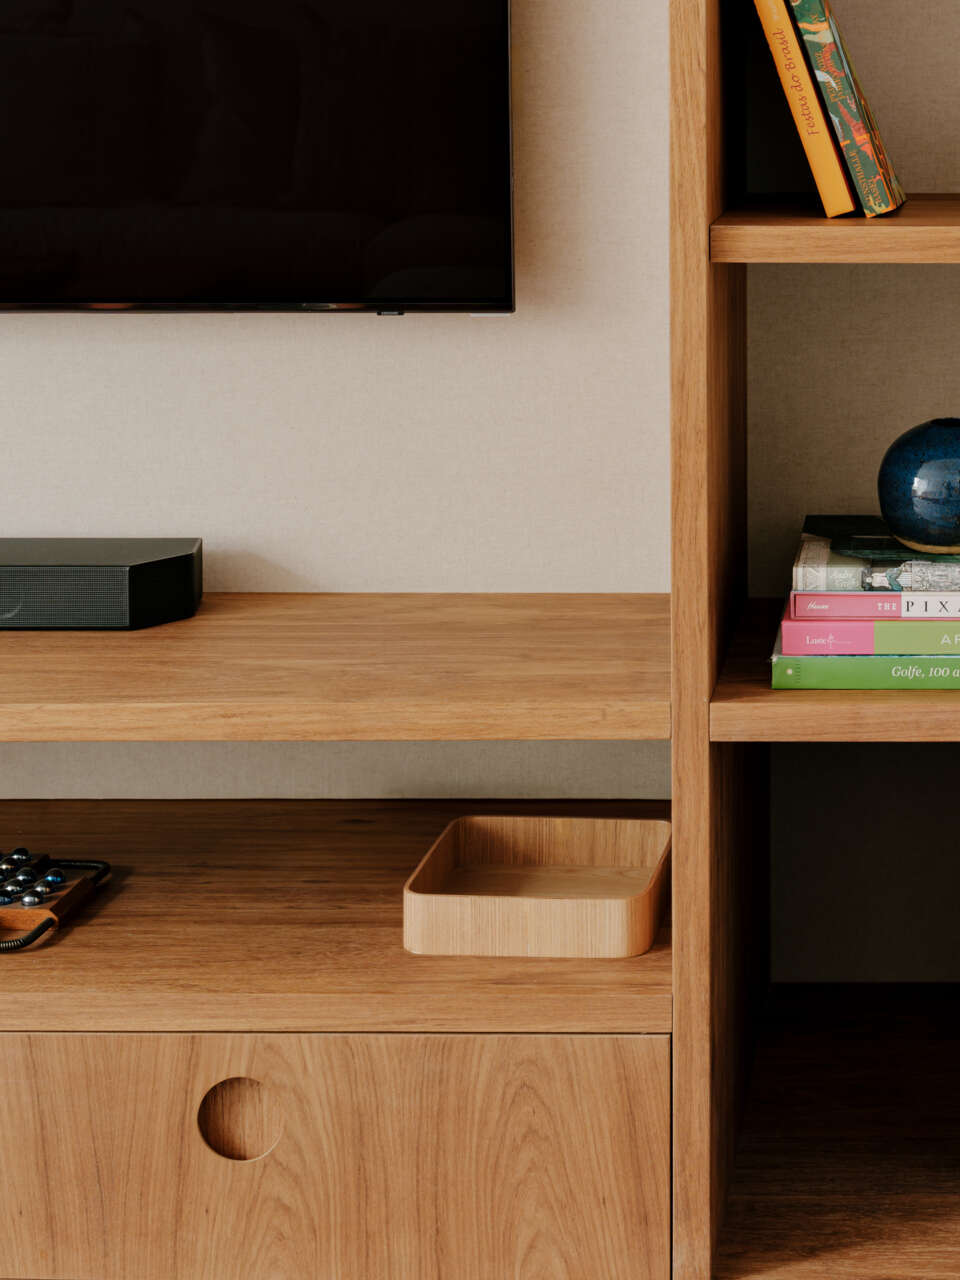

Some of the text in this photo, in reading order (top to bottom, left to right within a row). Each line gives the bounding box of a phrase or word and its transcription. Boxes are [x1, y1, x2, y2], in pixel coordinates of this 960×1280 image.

[772, 27, 820, 136] Festas do Brasil
[877, 602, 897, 611] THE
[940, 634, 952, 645] A
[891, 666, 926, 679] Golfe,
[928, 666, 950, 677] 100
